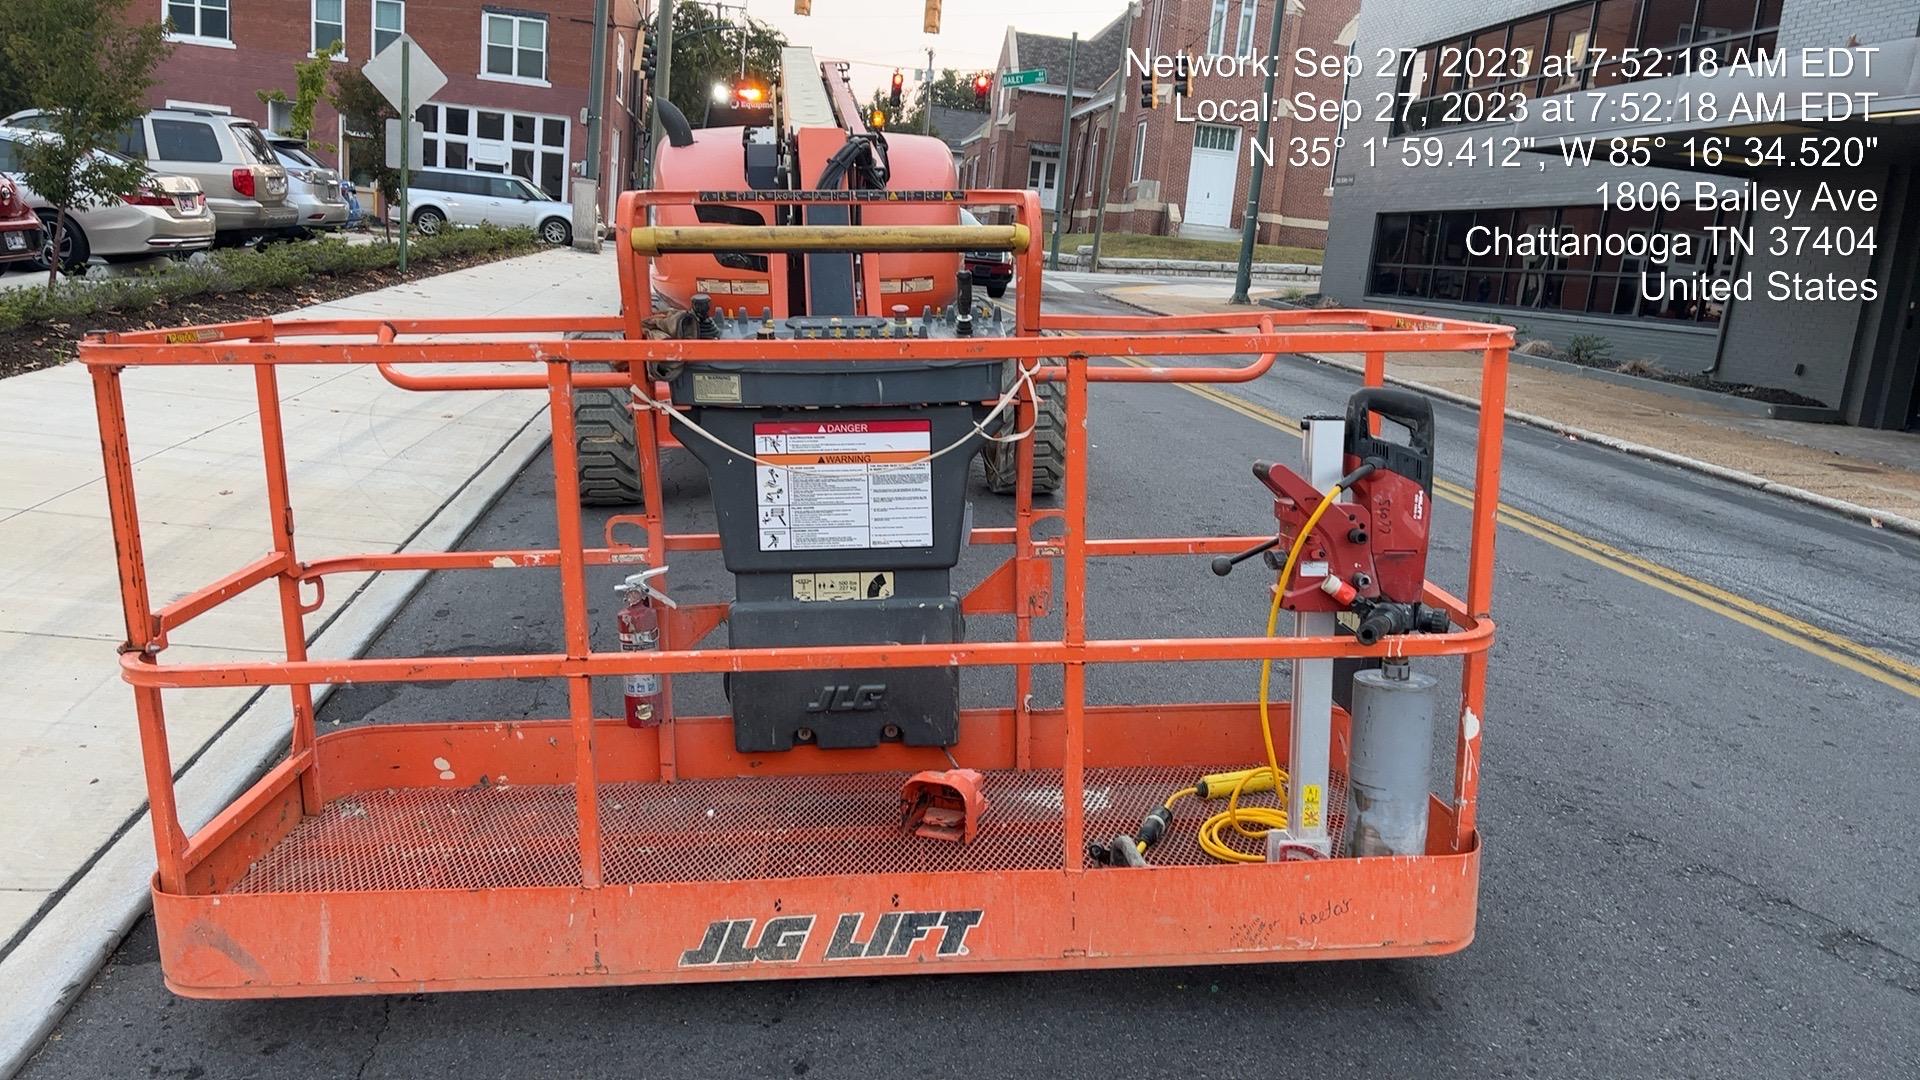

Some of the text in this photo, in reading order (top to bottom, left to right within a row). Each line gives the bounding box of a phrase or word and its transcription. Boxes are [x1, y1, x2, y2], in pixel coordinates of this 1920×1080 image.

[1003, 74, 1024, 86] BAILEY
[827, 423, 868, 433] DANGER
[825, 454, 871, 464] WARNING
[807, 684, 887, 712] JLG
[678, 910, 984, 967] JLG LIFT
